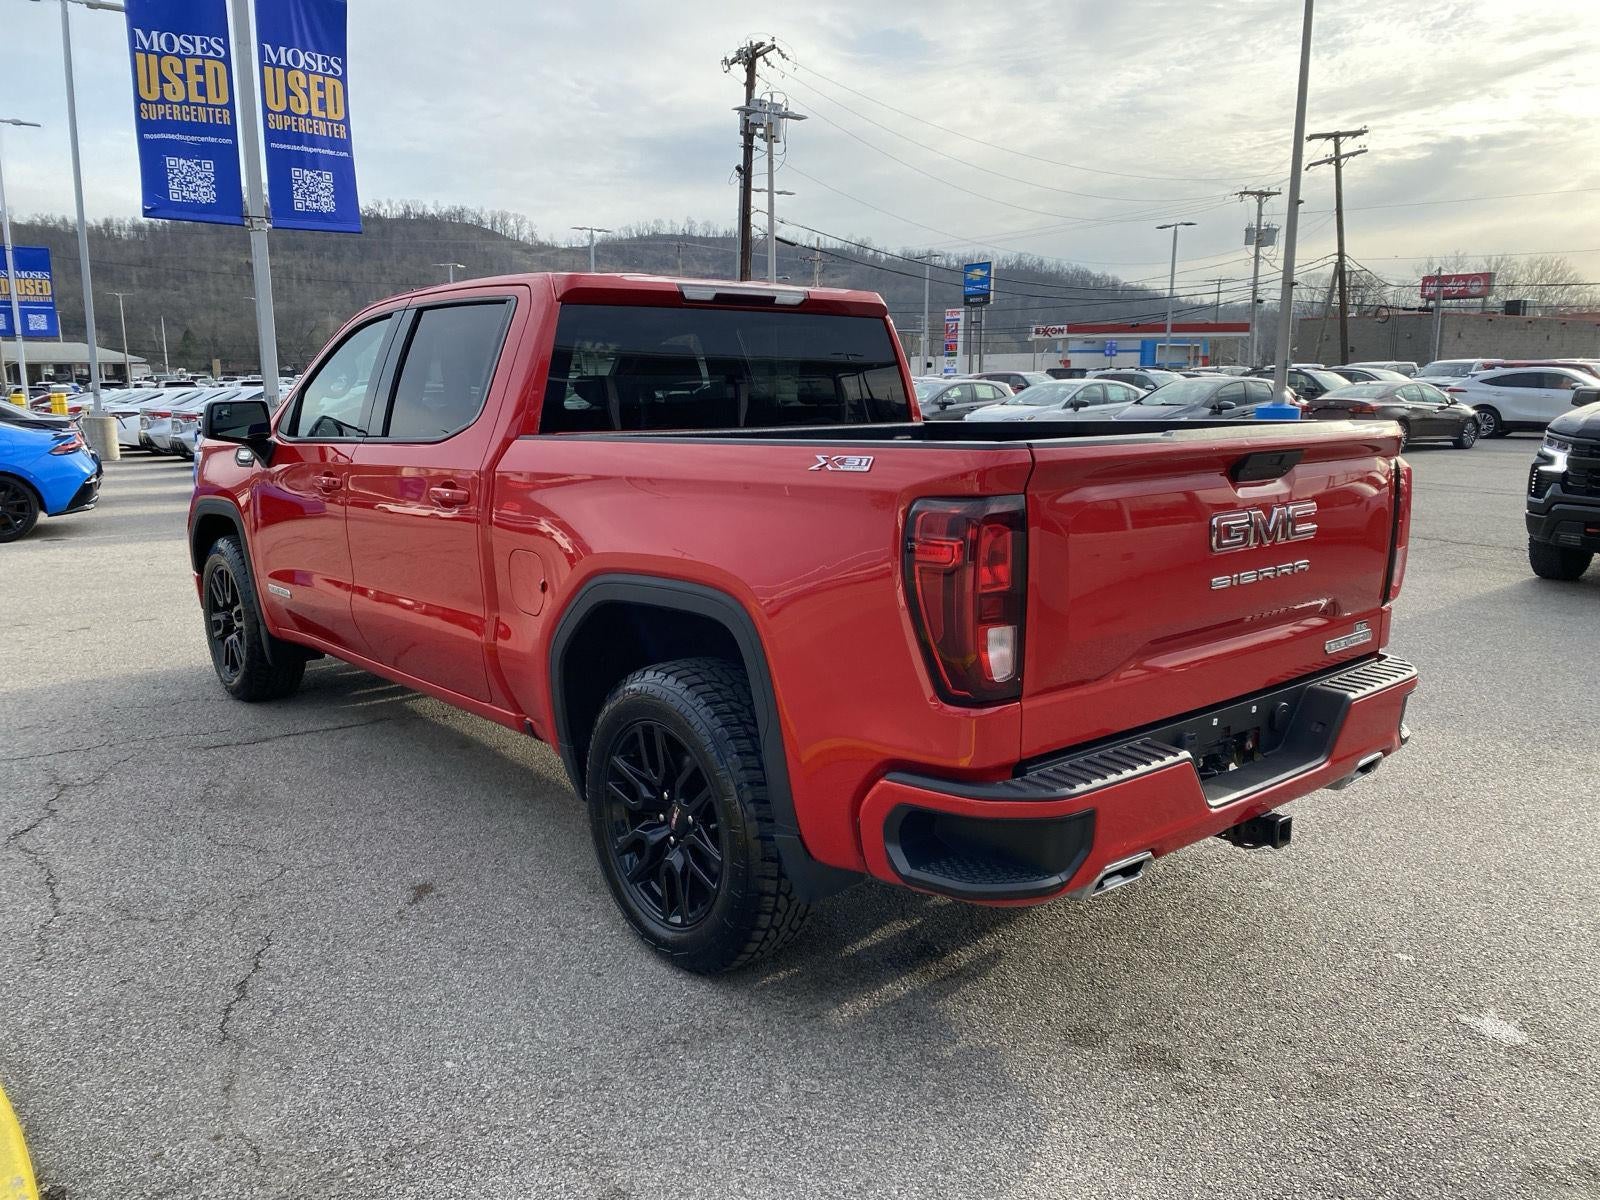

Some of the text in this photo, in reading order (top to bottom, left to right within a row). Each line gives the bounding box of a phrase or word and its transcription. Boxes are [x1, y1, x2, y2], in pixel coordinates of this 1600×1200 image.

[133, 28, 225, 58] MOSES
[262, 43, 343, 77] MOSES
[135, 52, 229, 105] USED
[263, 66, 345, 121] USED
[140, 103, 231, 125] SUPERCENTER
[267, 113, 347, 139] SUPERCENTER
[143, 132, 233, 145] mosesusedsupercenter.com
[270, 142, 349, 157] mosesusedsupercenter.com
[15, 270, 50, 279] MOSES
[15, 278, 52, 295] USED
[1034, 325, 1065, 338] EXXON
[808, 455, 875, 472] X31
[1209, 500, 1318, 554] GMC
[1211, 559, 1310, 590] SIERRA
